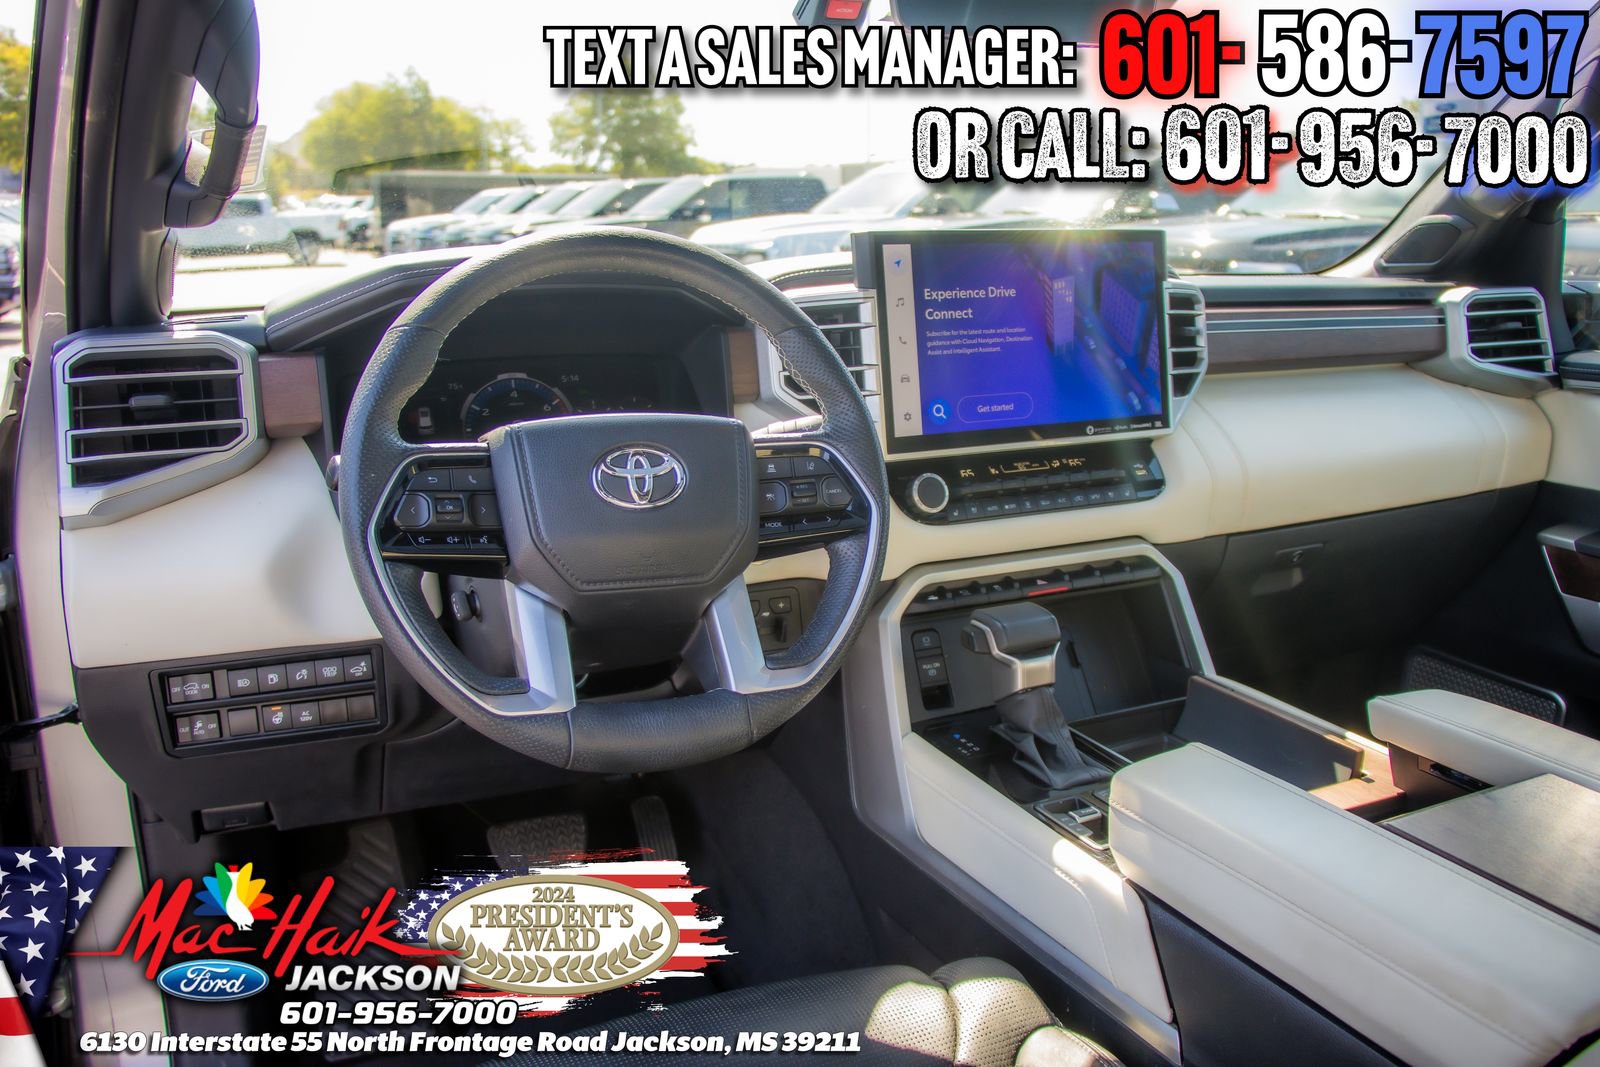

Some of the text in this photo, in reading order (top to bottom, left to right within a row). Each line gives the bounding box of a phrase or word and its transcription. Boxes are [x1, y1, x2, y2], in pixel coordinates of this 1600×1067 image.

[924, 286, 1017, 301] Experience Drive
[925, 307, 973, 321] Connect
[561, 375, 579, 383] 5:14
[510, 390, 518, 398] 4
[543, 403, 551, 411] 6
[977, 402, 1014, 413] Get started
[482, 408, 490, 416] 2
